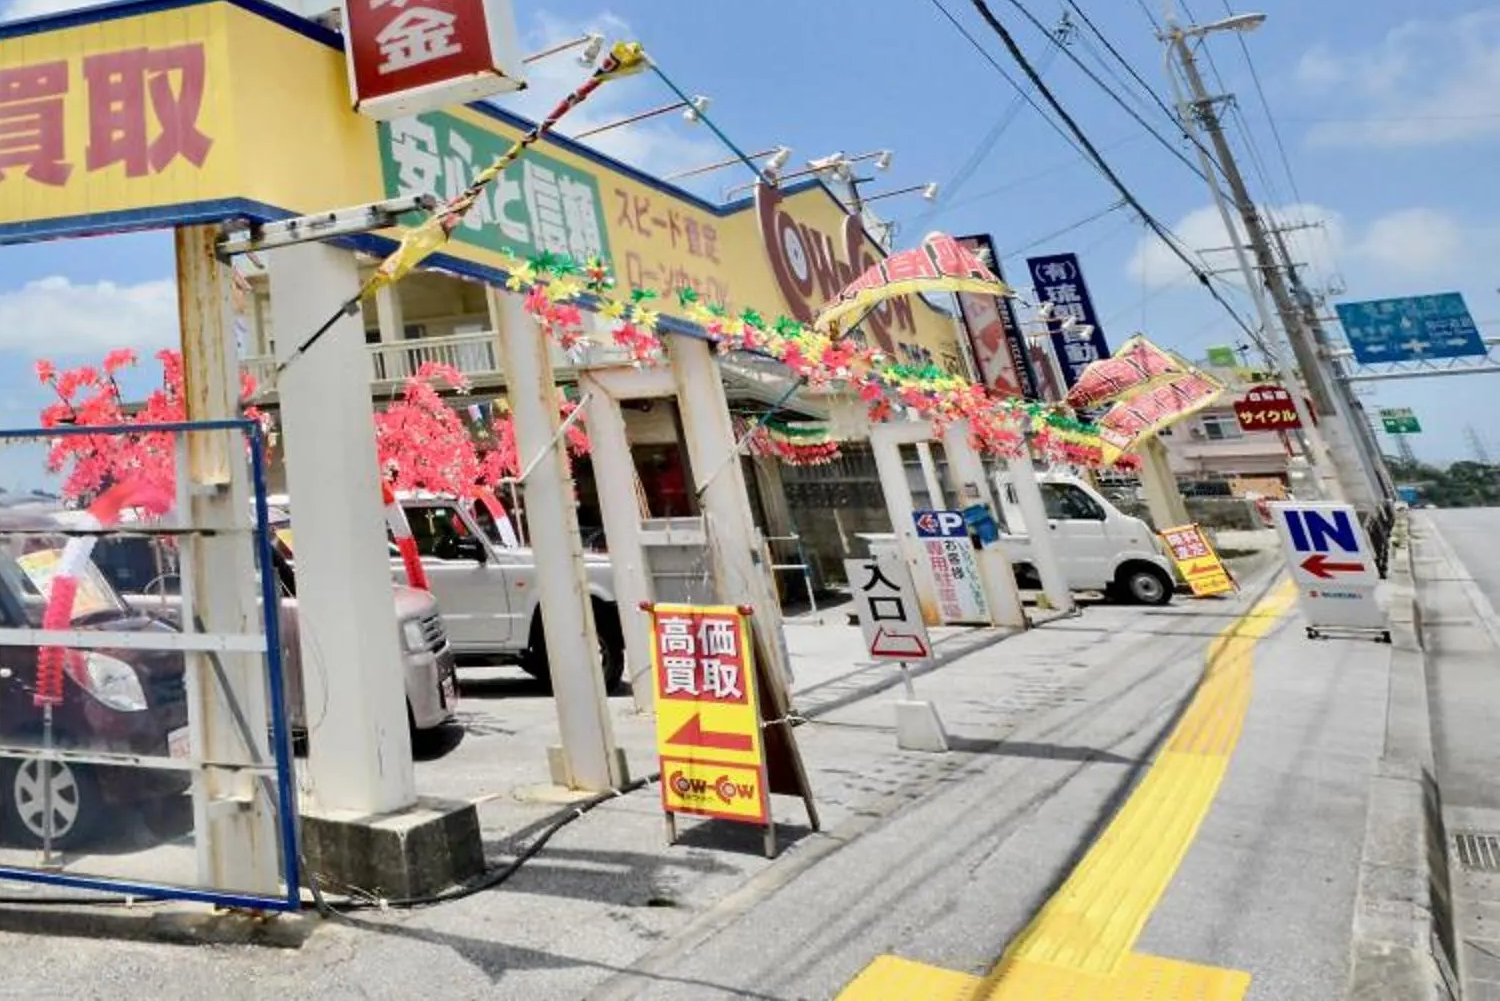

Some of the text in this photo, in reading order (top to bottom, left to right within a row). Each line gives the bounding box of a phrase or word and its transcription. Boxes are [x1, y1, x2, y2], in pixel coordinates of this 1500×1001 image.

[1239, 408, 1297, 424] サイクル
[937, 512, 963, 536] P
[1283, 510, 1360, 552] IN
[862, 563, 908, 623] 入口
[659, 616, 738, 656] 高価
[662, 655, 743, 699] 買取
